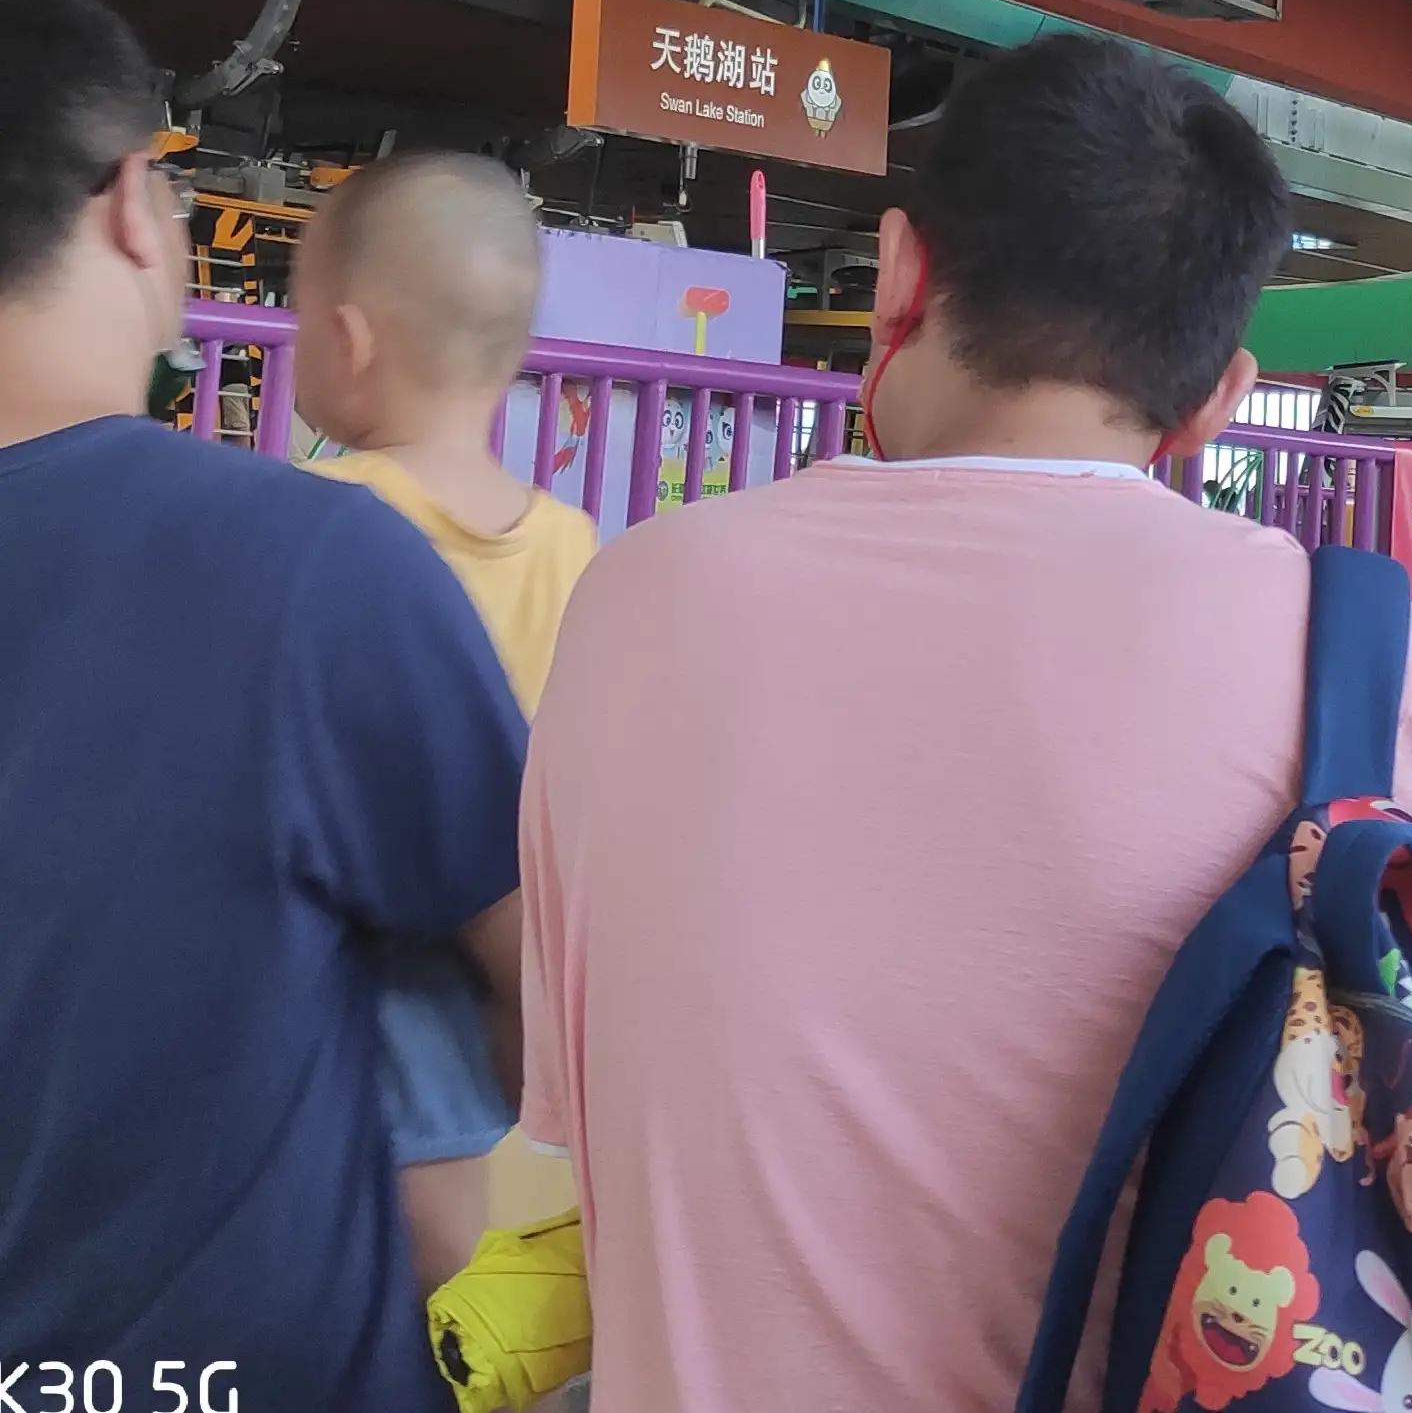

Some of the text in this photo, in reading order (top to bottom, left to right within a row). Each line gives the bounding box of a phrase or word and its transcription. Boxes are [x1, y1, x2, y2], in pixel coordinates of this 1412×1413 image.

[650, 26, 779, 96] 天鹅湖站
[660, 92, 765, 128] Swan Lake Station
